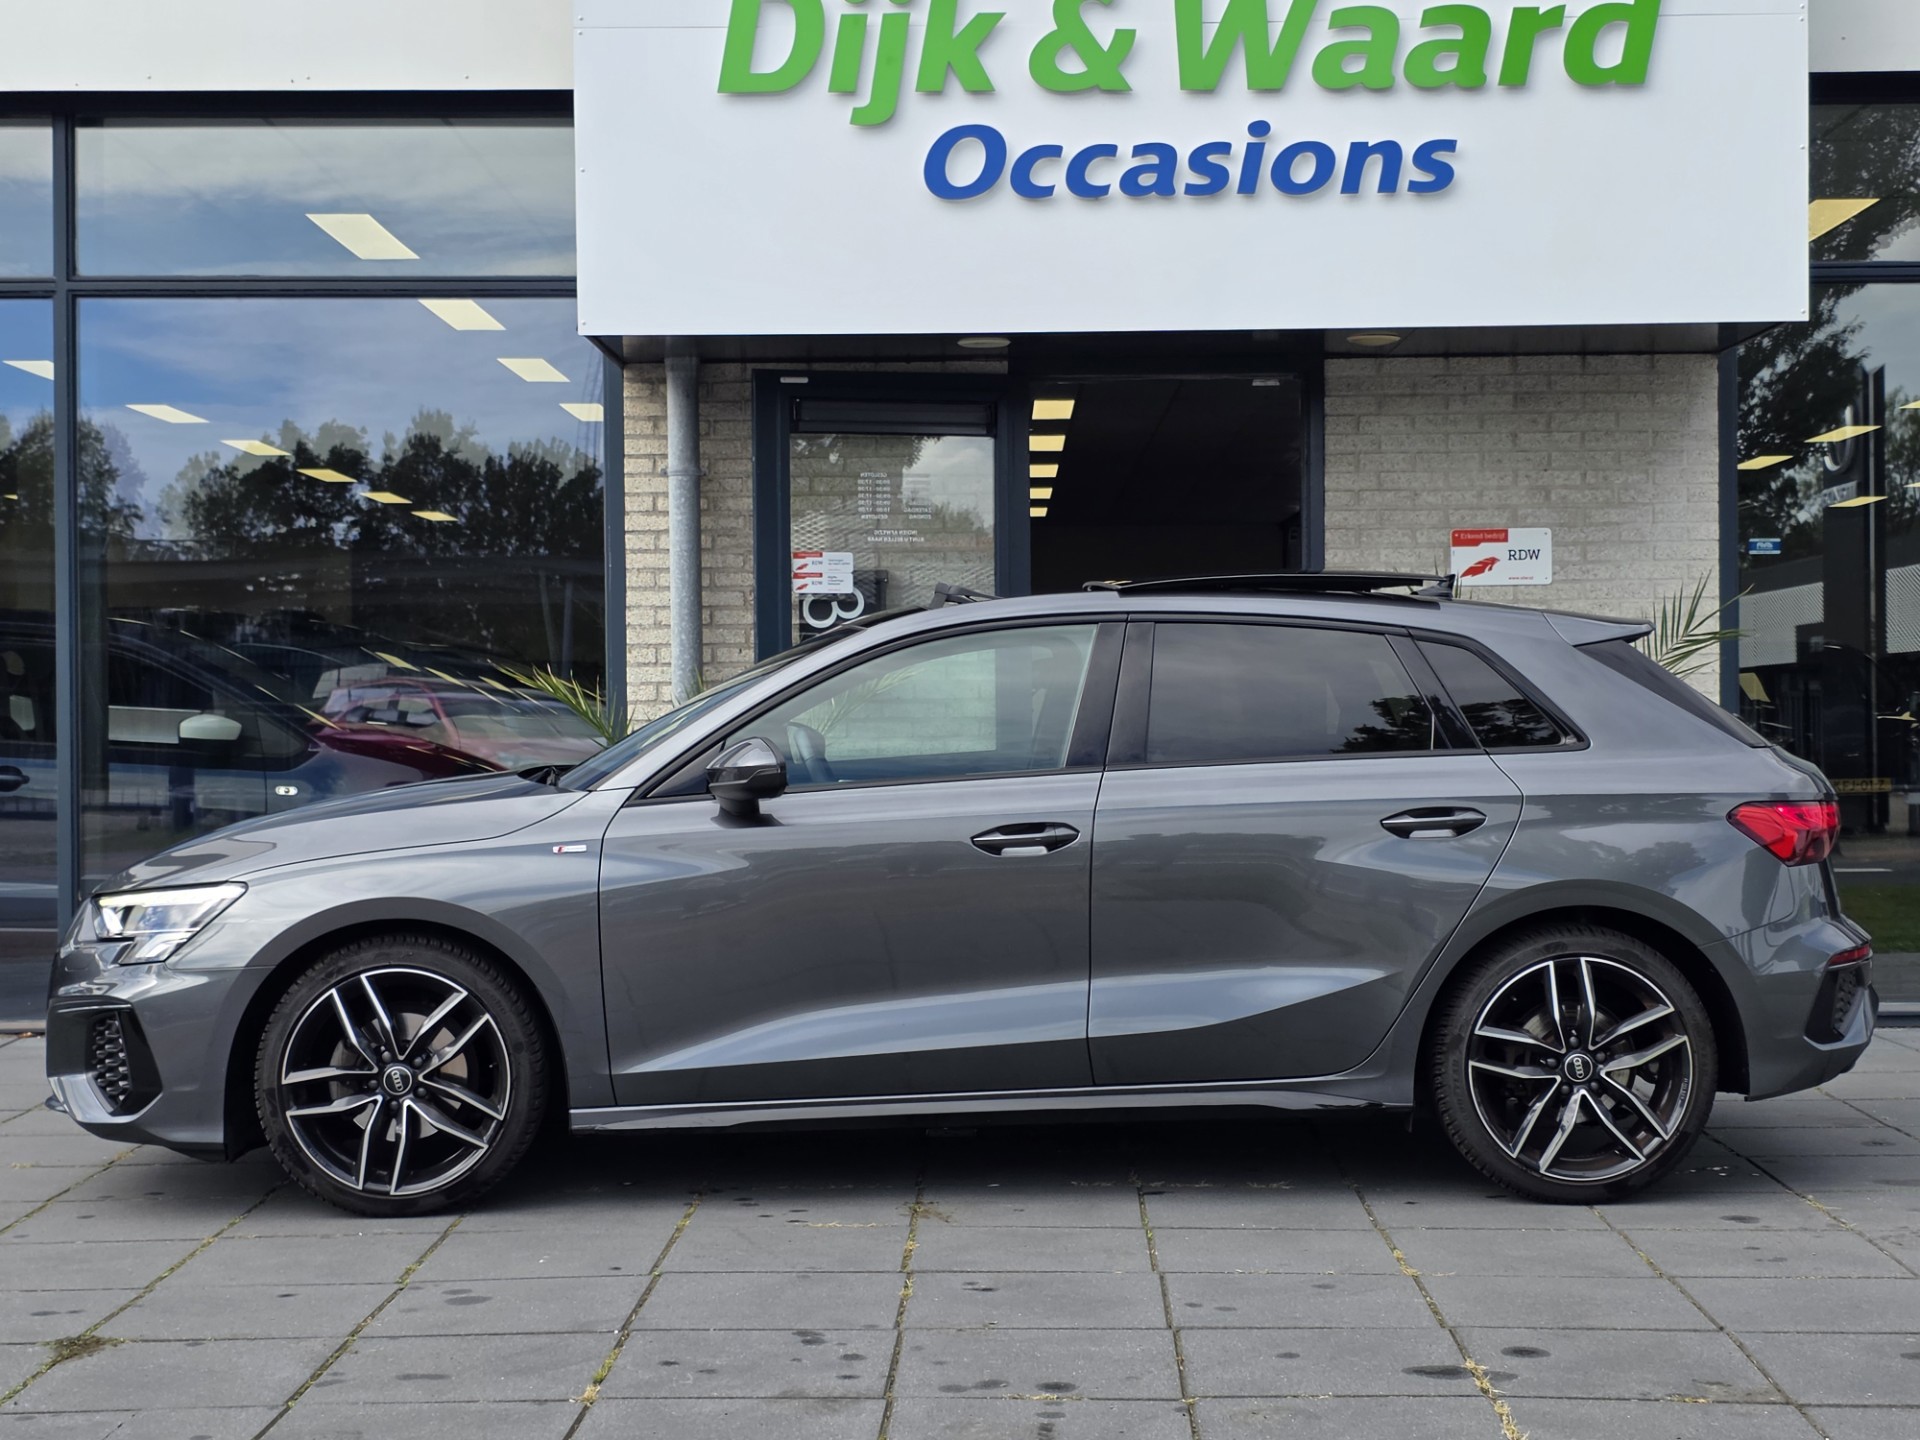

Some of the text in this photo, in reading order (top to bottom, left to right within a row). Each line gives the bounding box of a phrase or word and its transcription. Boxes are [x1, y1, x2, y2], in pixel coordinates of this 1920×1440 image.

[717, 0, 1662, 127] Dijk & Waard
[922, 119, 1458, 201] Occasions
[1508, 549, 1541, 561] RDW
